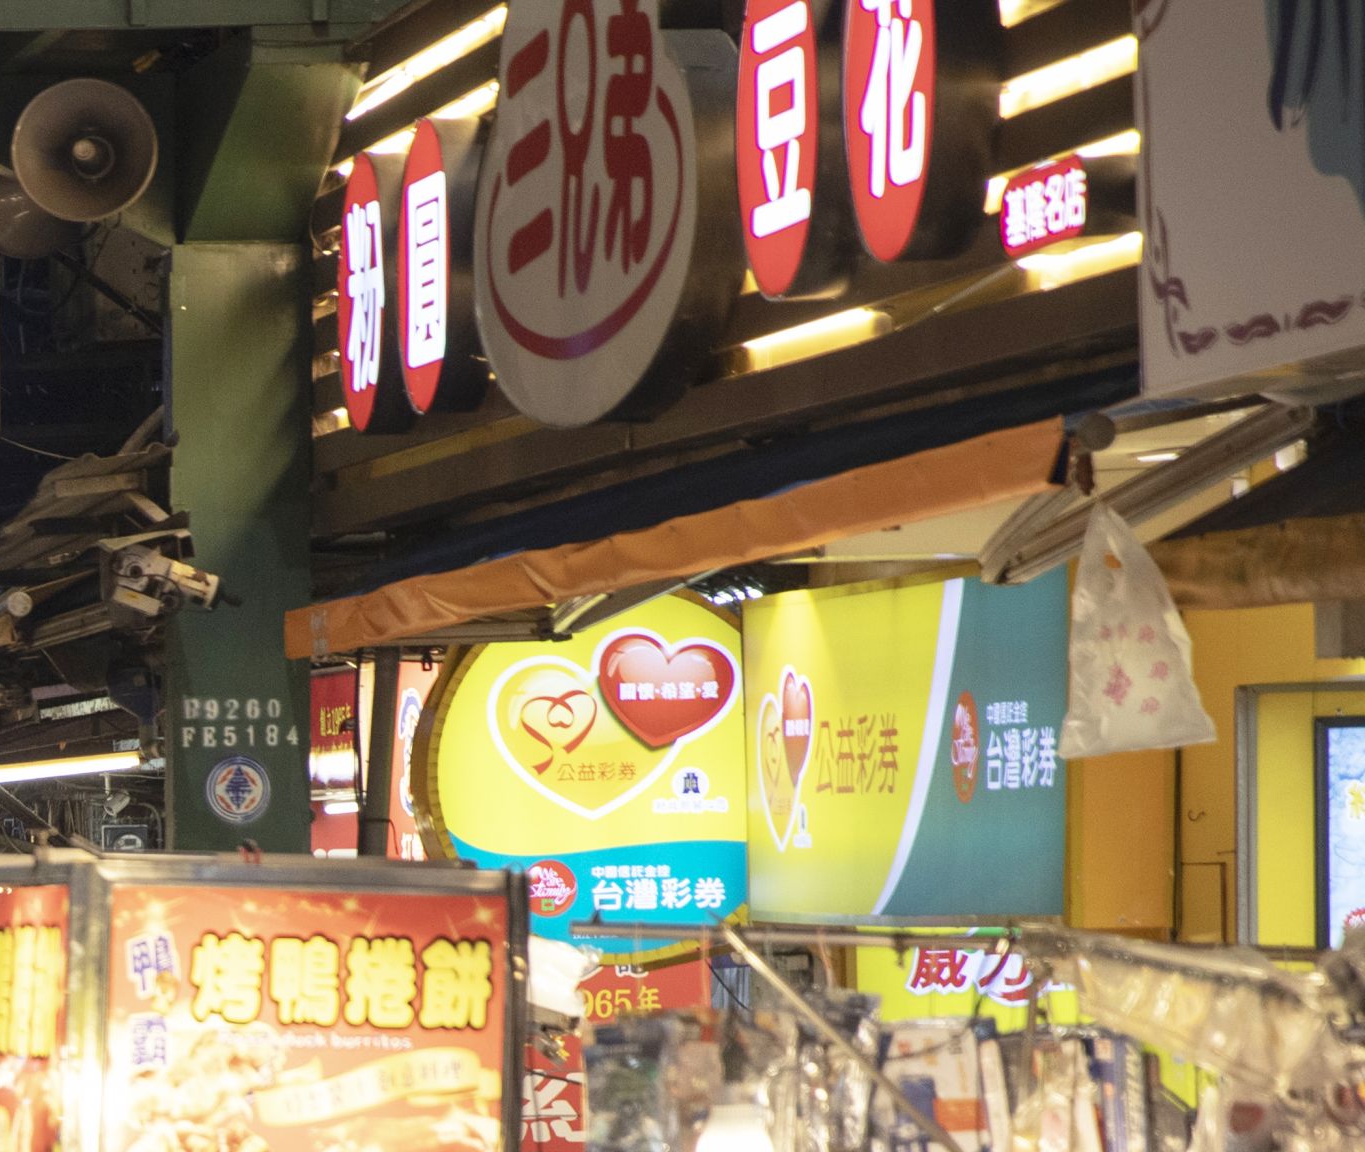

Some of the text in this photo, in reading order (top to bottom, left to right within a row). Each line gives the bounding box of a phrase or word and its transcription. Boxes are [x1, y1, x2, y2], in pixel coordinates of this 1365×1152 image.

[1005, 167, 1087, 248] 基隆名店
[346, 169, 447, 392] 粉圓
[181, 698, 282, 720] B9260
[181, 726, 301, 748] FE5184
[557, 762, 637, 782] 公益彩券
[815, 711, 899, 795] 公益彩券
[985, 726, 1058, 792] 台灣彩券
[591, 878, 727, 911] 台灣彩券
[190, 930, 494, 1031] 烤鴨捲餅
